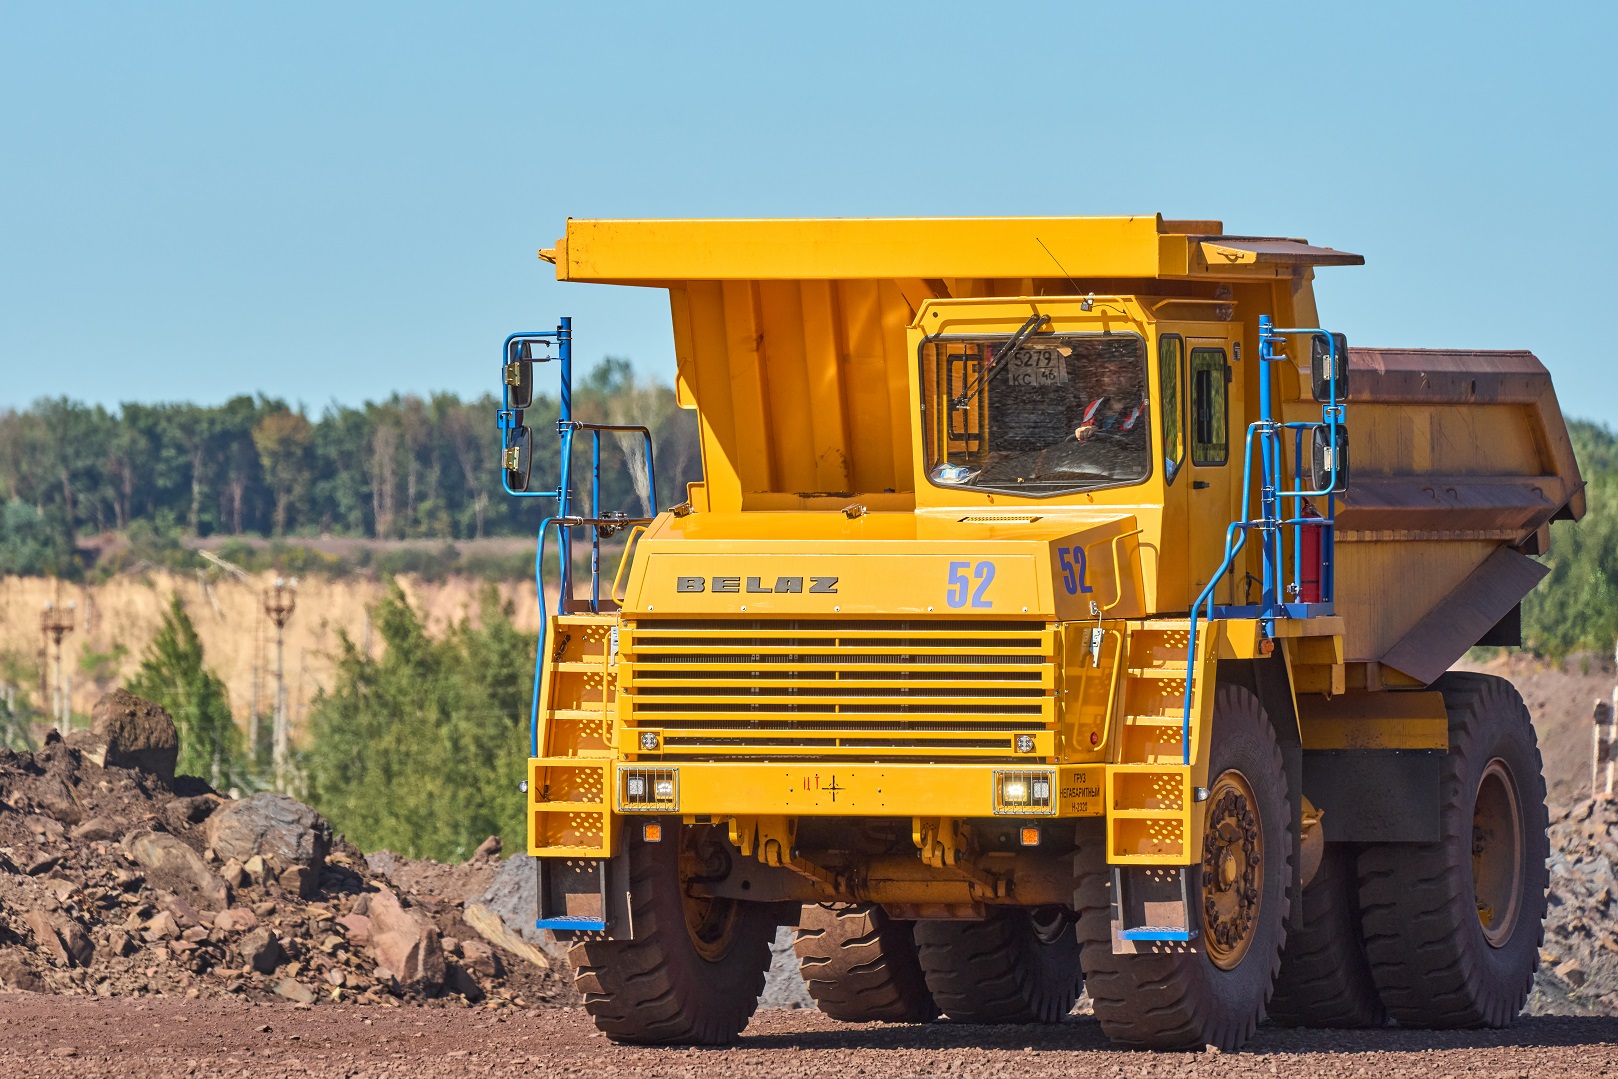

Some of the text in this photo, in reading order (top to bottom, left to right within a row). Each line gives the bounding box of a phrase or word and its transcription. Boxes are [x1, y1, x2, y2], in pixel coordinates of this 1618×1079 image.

[1014, 351, 1052, 367] 5279
[1041, 369, 1056, 381] 46
[1057, 545, 1093, 595] 52
[676, 576, 839, 594] BELAZ
[946, 561, 995, 609] 52
[1073, 773, 1087, 783] ГРУЗ
